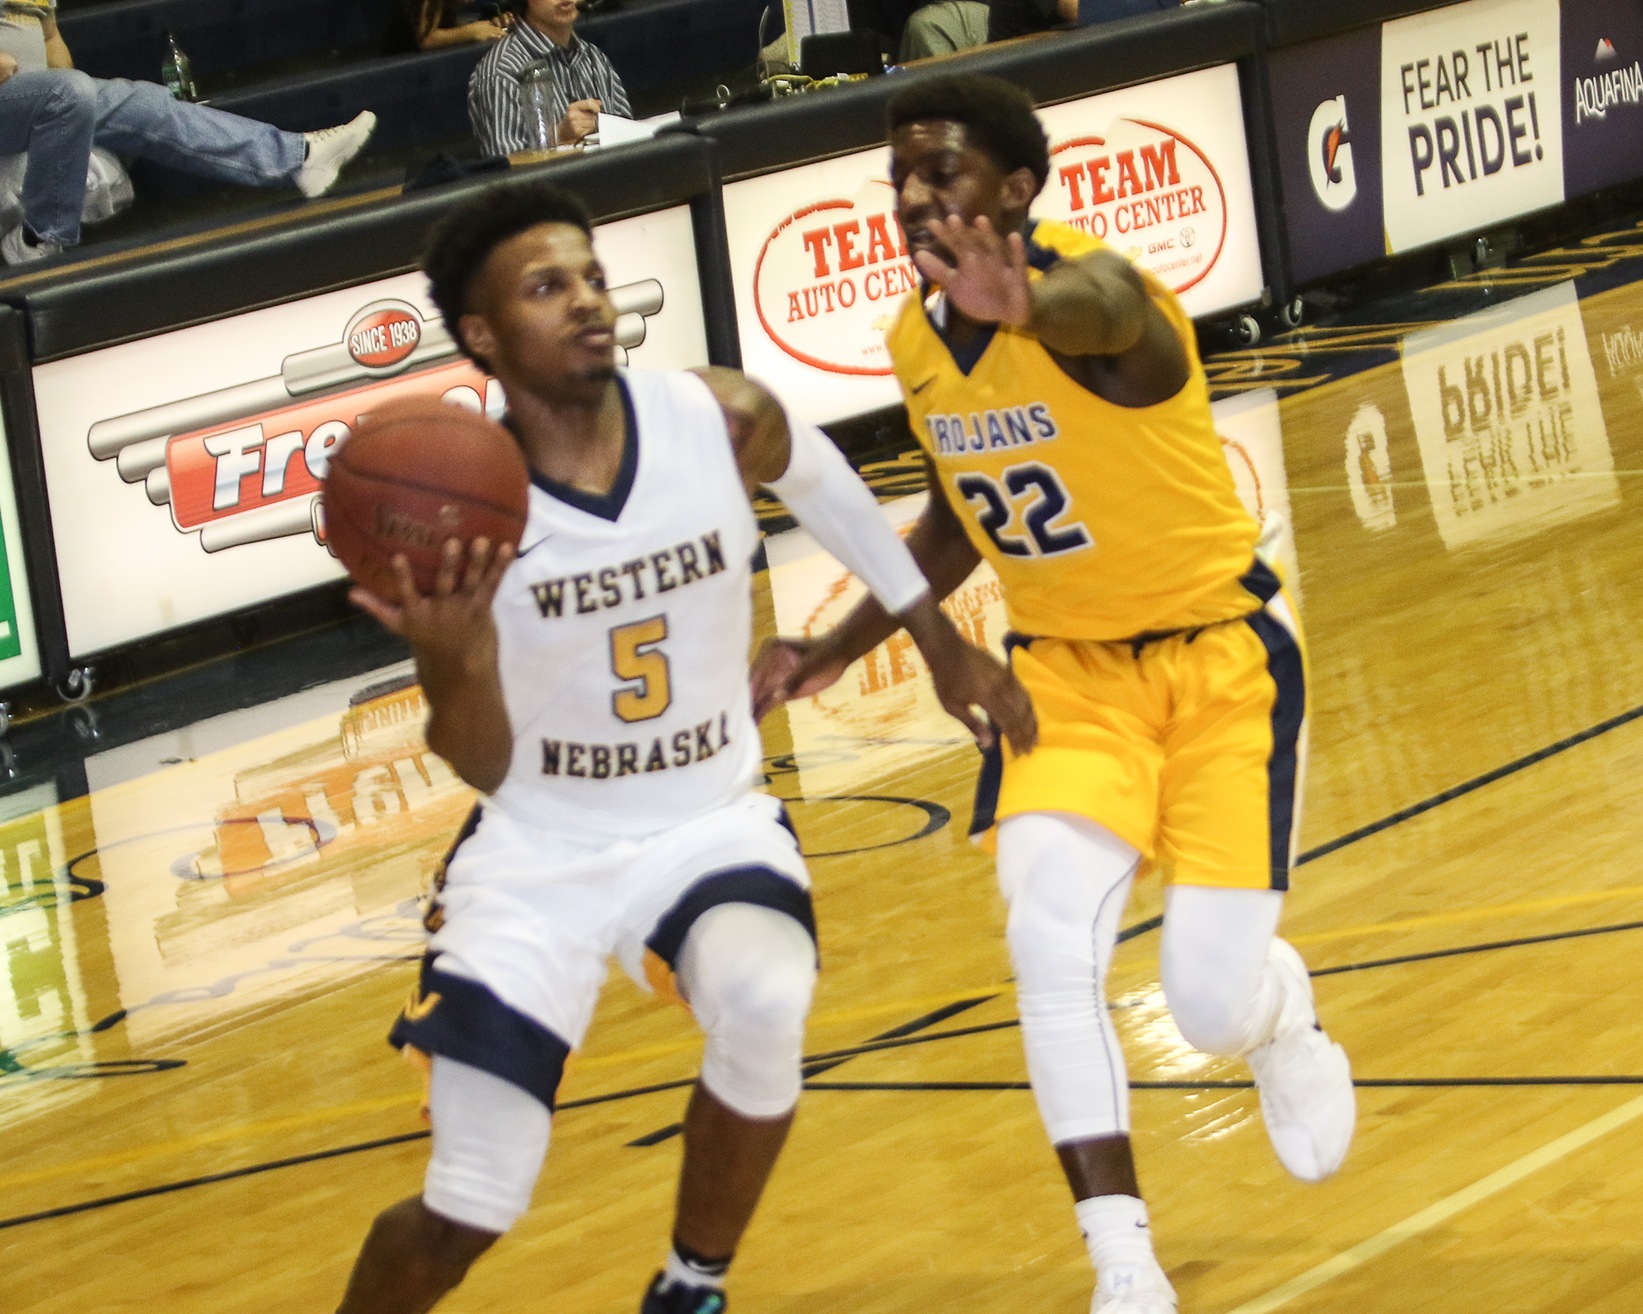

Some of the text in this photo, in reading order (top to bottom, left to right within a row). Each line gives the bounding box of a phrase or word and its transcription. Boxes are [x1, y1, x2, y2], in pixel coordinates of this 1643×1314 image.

[1401, 32, 1533, 115] FEAR THE
[1575, 60, 1643, 125] AQUAFINA
[1058, 138, 1181, 211] TEAM
[1408, 91, 1544, 197] PRIDE!
[1115, 185, 1206, 234] CENTER
[1148, 238, 1175, 254] GMC
[787, 262, 917, 323] AUTO CEN
[351, 320, 417, 355] SINCE 1938
[955, 459, 1095, 559] 22
[529, 529, 727, 619] WESTERN
[608, 612, 672, 723] 5
